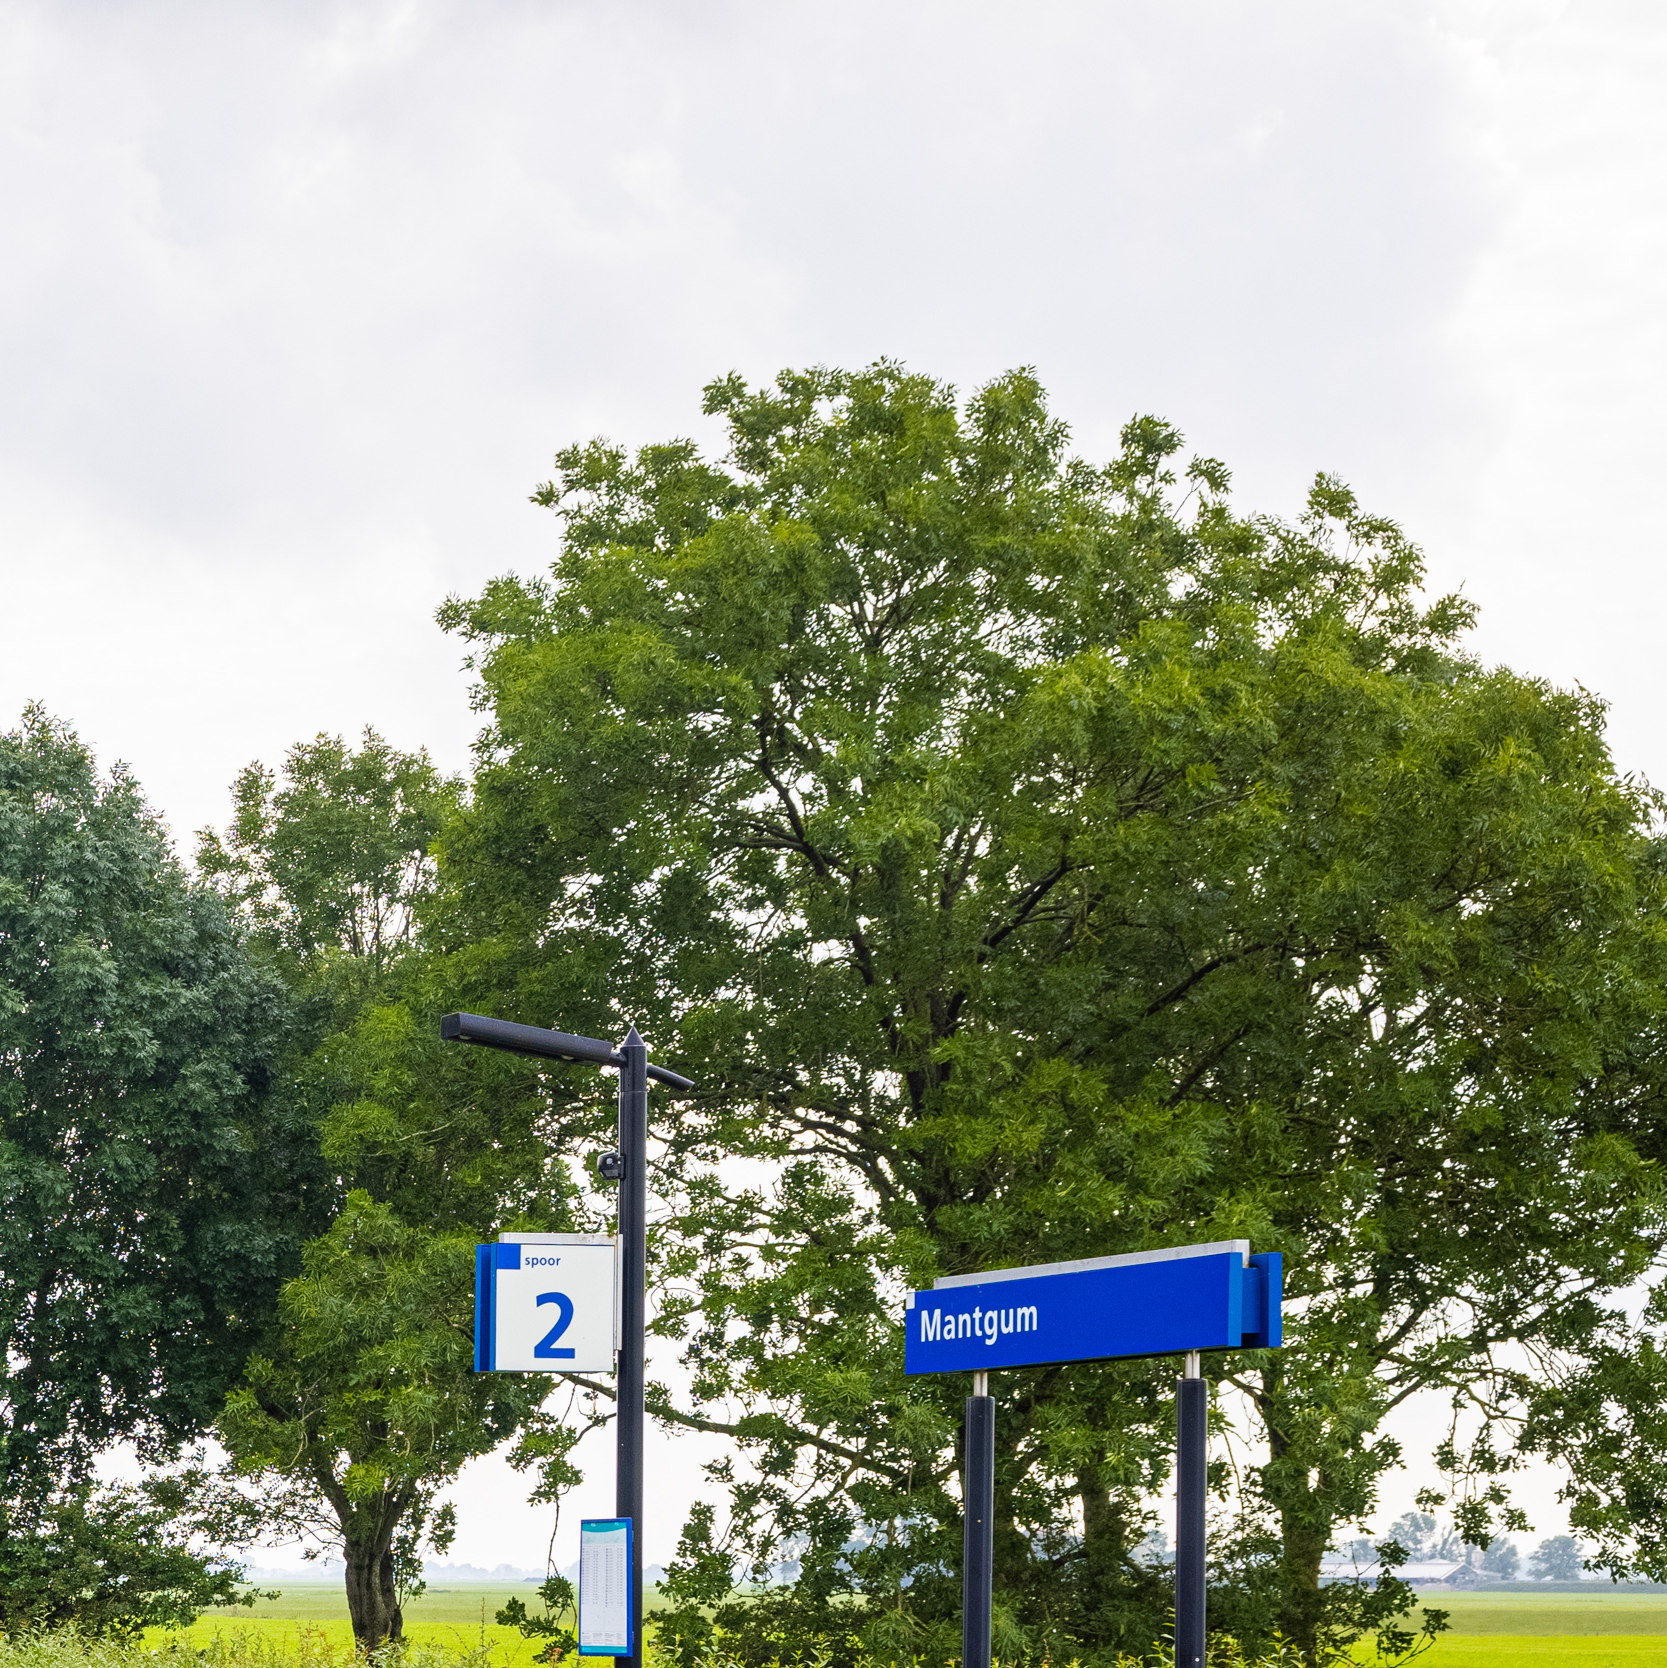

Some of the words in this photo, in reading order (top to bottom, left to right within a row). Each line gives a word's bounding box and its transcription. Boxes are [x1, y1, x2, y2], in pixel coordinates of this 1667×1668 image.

[524, 1257, 561, 1268] spoor
[534, 1291, 575, 1359] 2
[920, 1305, 1038, 1345] Mantgum
